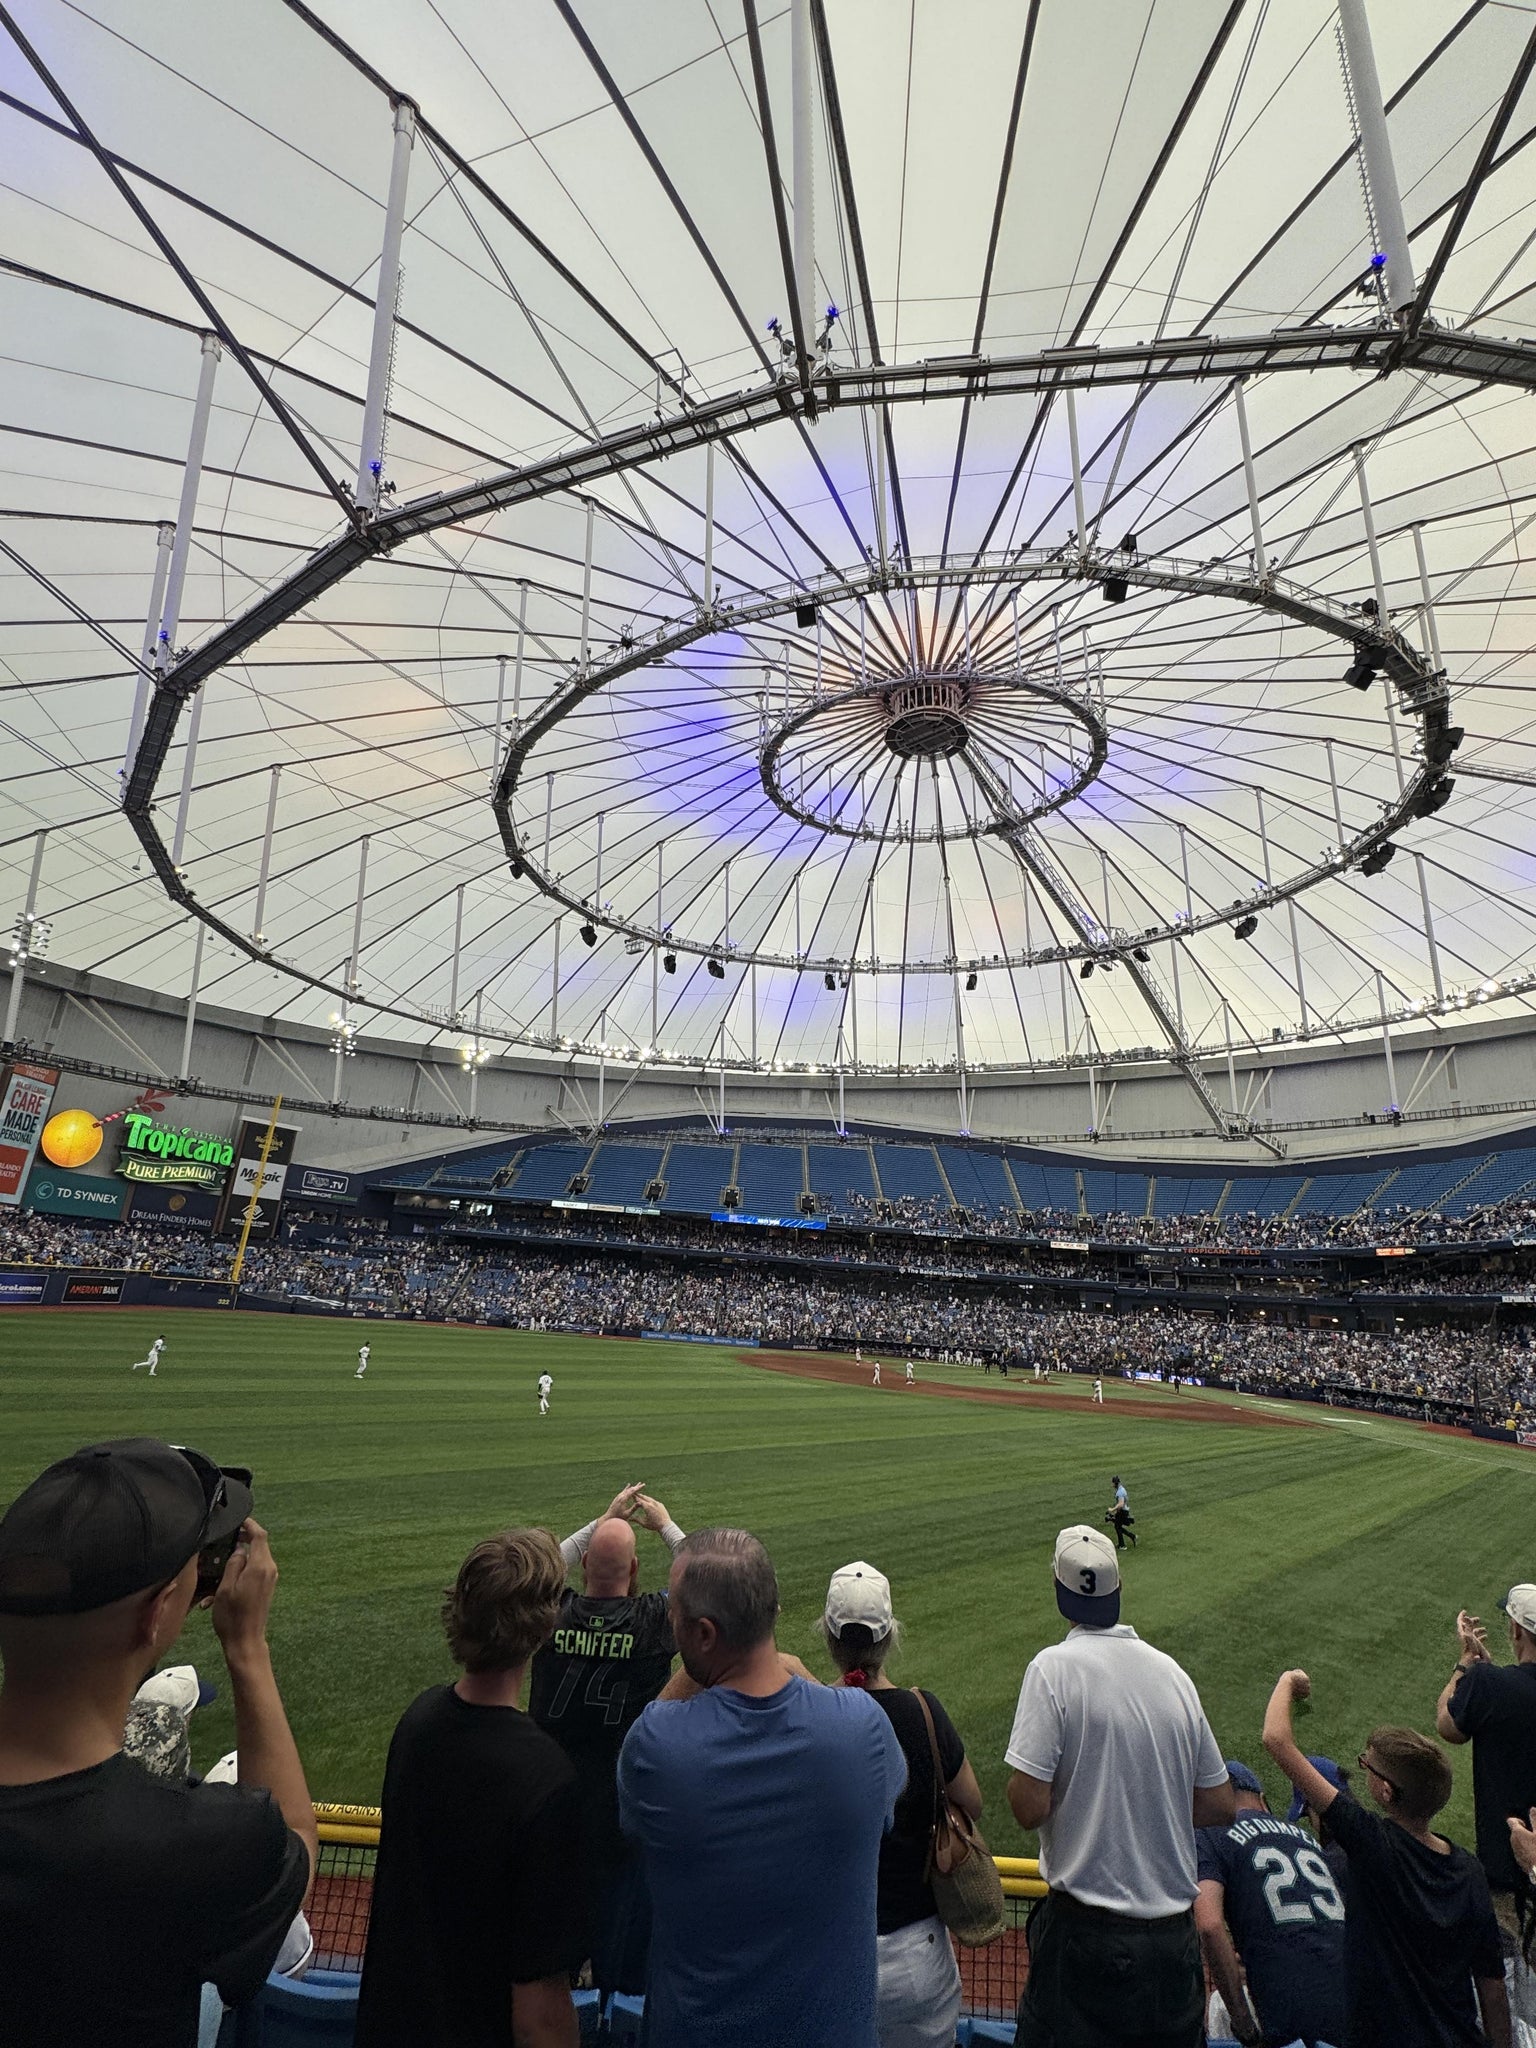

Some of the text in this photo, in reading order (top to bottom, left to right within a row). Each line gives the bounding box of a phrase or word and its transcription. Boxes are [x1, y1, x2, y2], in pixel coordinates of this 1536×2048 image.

[10, 1089, 47, 1115] CARE
[3, 1109, 40, 1134] MADE
[155, 1122, 176, 1131] THE
[0, 1128, 33, 1145] PERSONAL
[124, 1113, 234, 1166] Tropicana
[0, 1162, 22, 1172] RLANDO
[0, 1168, 16, 1178] EALTH
[126, 1160, 217, 1182] PURE PREMIUM
[57, 1187, 118, 1204] TD SYNNEX
[131, 1209, 212, 1228] DREAM FINDERS HOMES
[1183, 1247, 1231, 1255] TROPICANA
[945, 1271, 963, 1279] Group
[69, 1284, 120, 1296] AMERANT BANK
[1501, 1295, 1533, 1303] REPUBLIC
[1080, 1569, 1096, 1595] 3
[554, 1629, 634, 1659] SCHIFFER
[1227, 1820, 1260, 1846] BIG
[1252, 1846, 1346, 1925] 29
